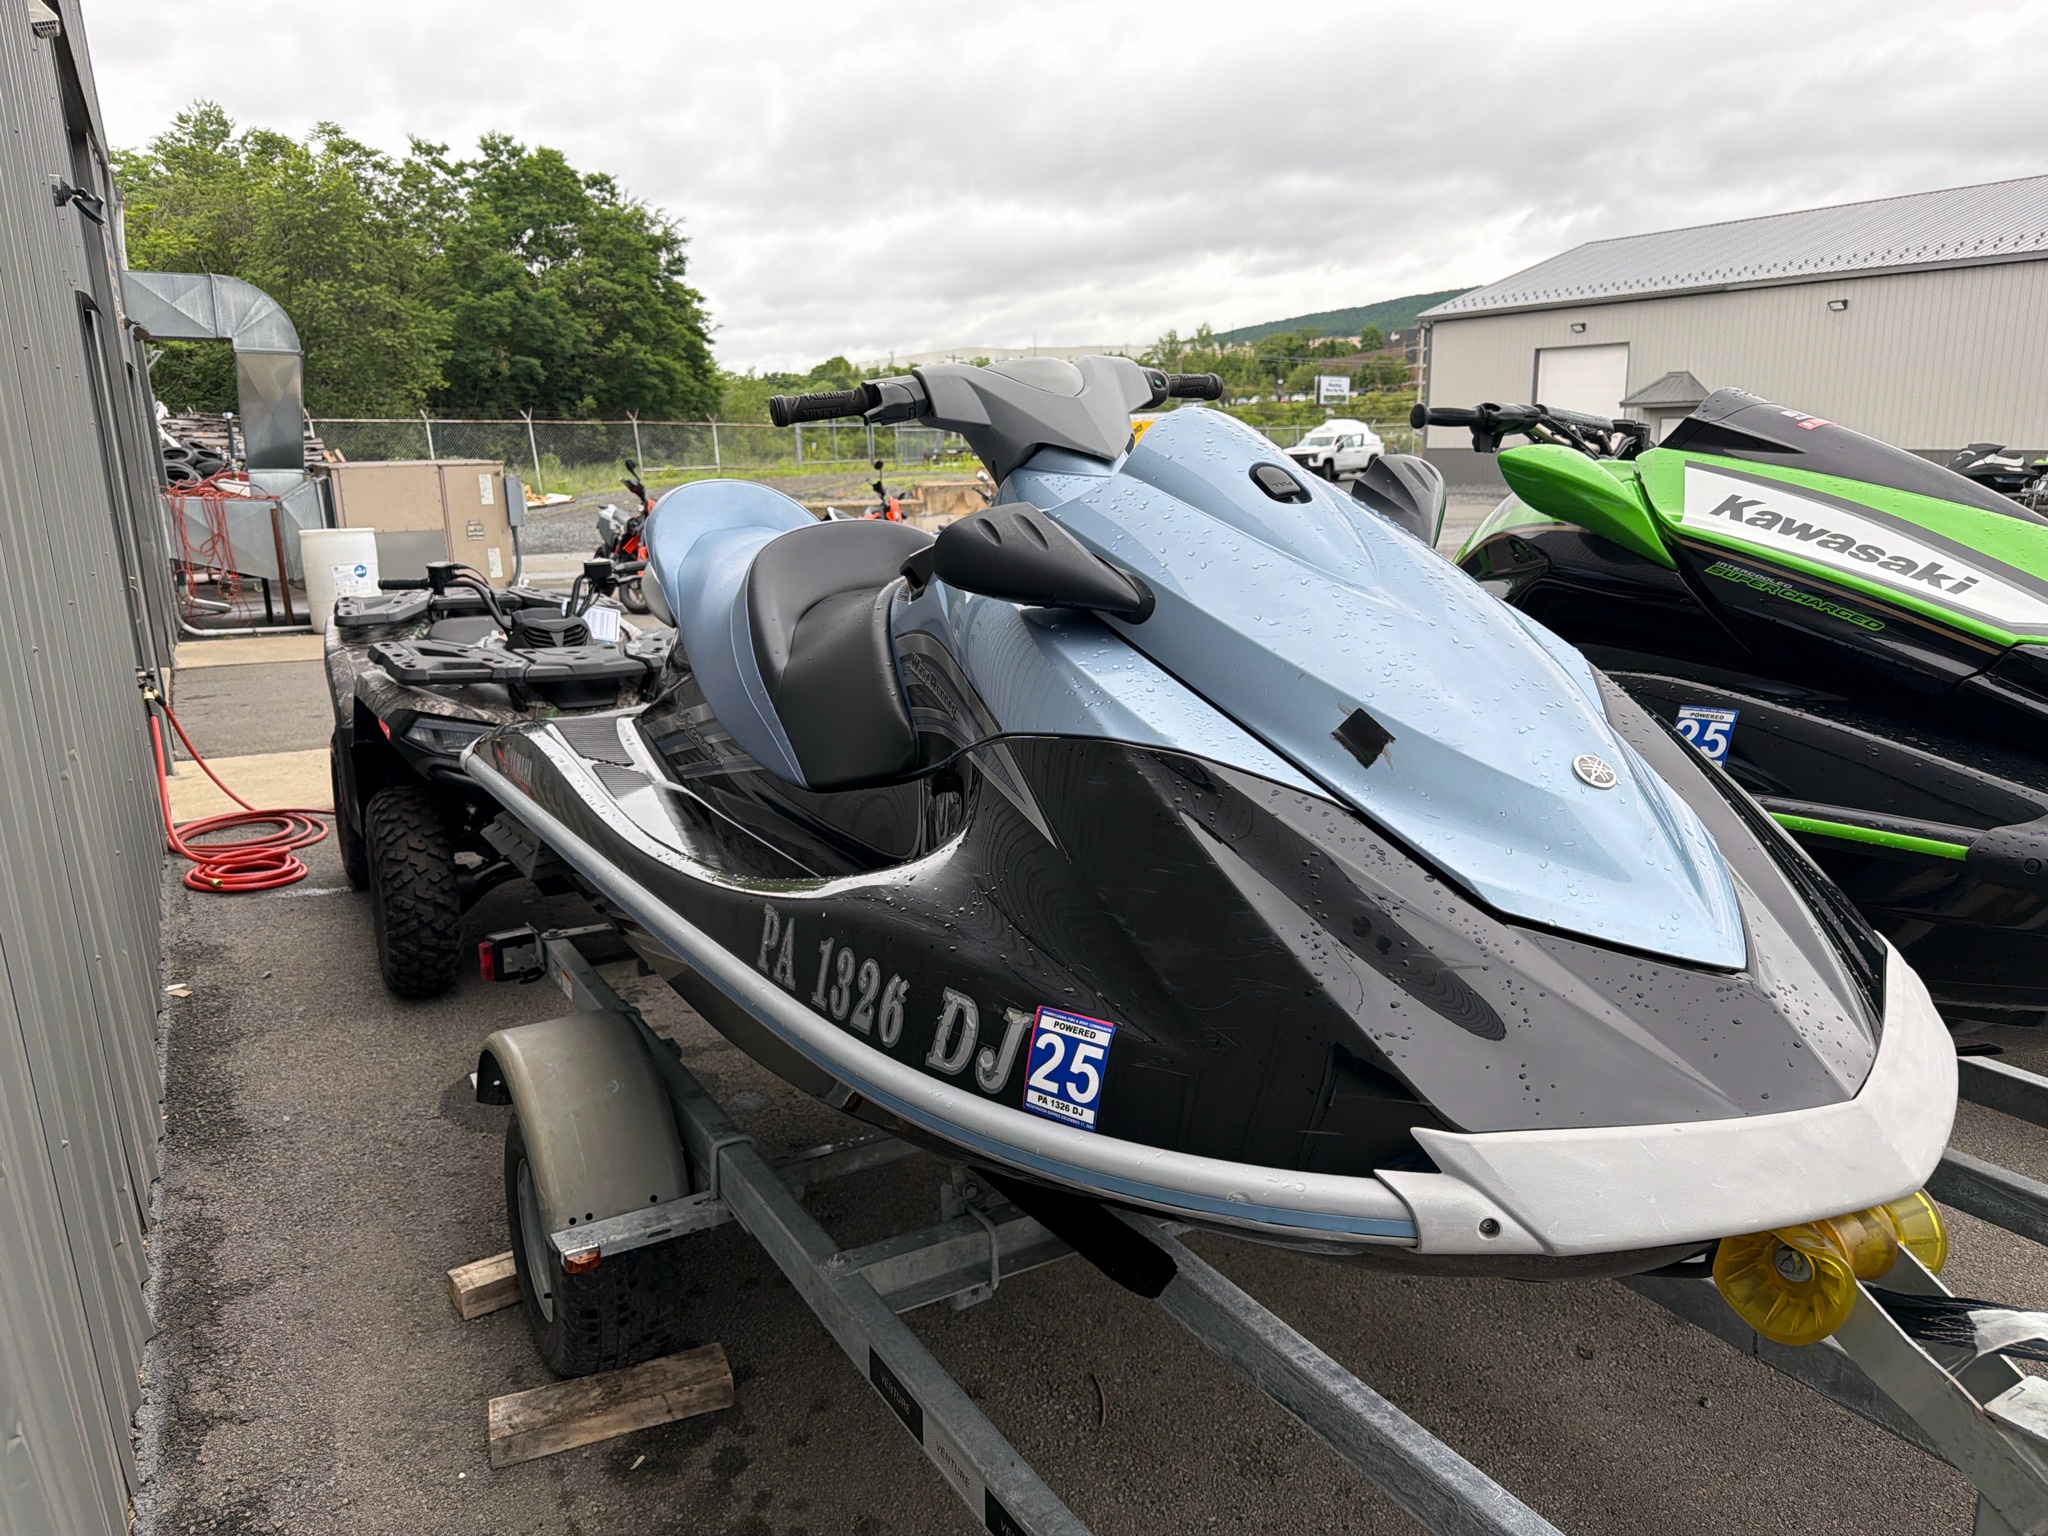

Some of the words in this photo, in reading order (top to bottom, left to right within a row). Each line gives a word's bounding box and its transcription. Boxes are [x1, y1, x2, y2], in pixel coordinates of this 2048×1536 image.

[1709, 494, 1979, 595] Kawasaki
[1716, 561, 1793, 589] INTERCOOLED
[1690, 712, 1725, 720] POWERED
[690, 729, 725, 765] CRUISER
[1675, 718, 1731, 758] 25
[757, 903, 796, 992] PA
[811, 936, 911, 1048] 1326
[925, 986, 1036, 1095] DJ
[1053, 1021, 1097, 1039] POWERED
[1028, 1032, 1104, 1104] 25
[1037, 1094, 1048, 1106] PA
[1050, 1099, 1071, 1113] 1326
[1072, 1106, 1084, 1117] DJ
[880, 1372, 912, 1416] VENTURE
[935, 1440, 971, 1490] VENTURE
